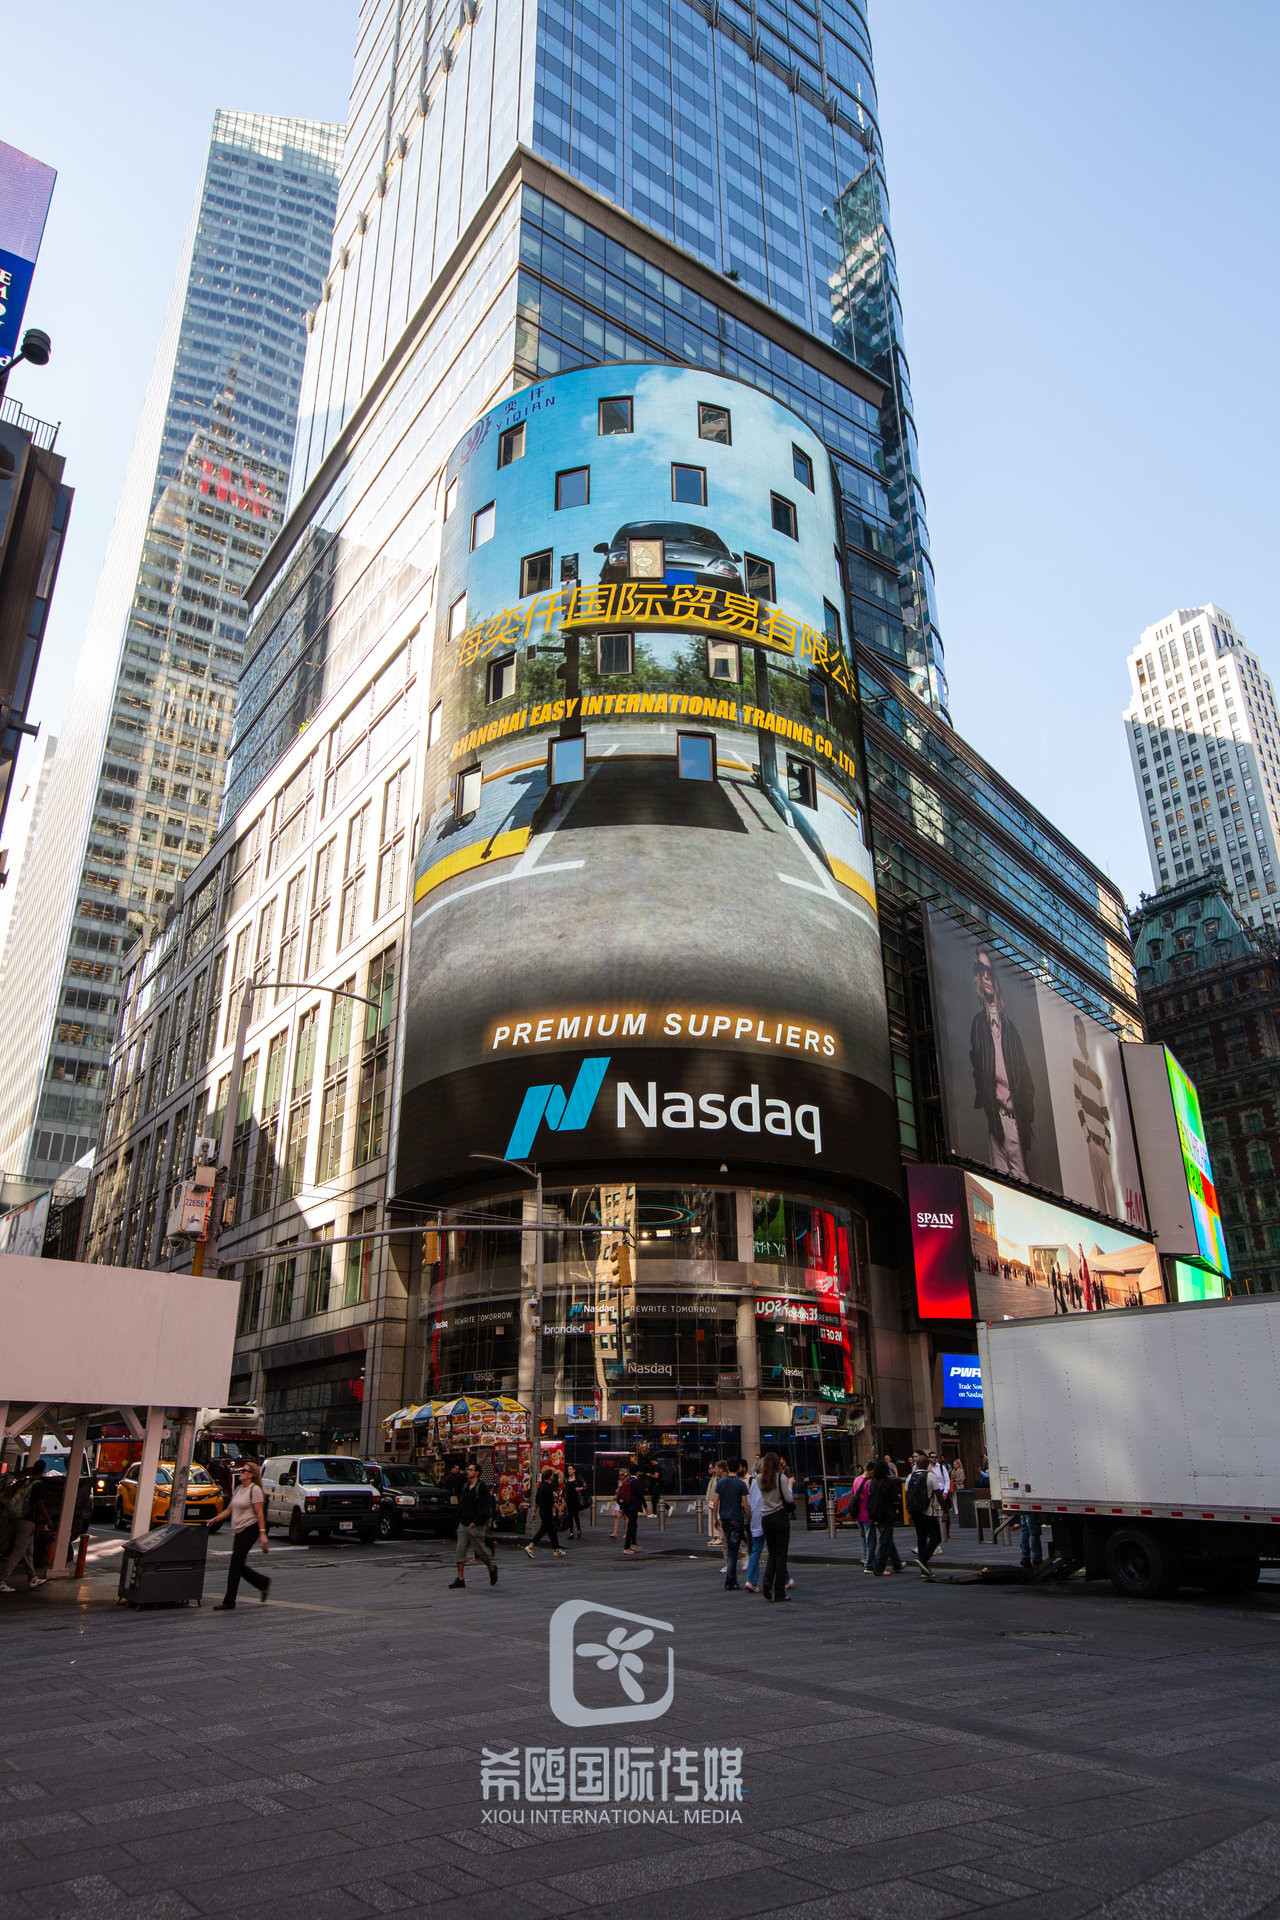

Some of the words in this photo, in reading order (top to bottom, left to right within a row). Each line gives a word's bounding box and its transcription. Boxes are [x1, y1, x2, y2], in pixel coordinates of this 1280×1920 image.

[496, 396, 555, 431] YIQIAN
[431, 583, 858, 703] 上海奕仟国际贸易有限公
[451, 709, 528, 762] SHANGHAI
[529, 697, 579, 727] EASY
[579, 693, 738, 721] INTERNATIONAL
[743, 705, 813, 746] TRADING
[839, 750, 856, 778] LTD
[492, 1013, 647, 1050] PREMIUM
[663, 1013, 836, 1056] SUPPLIERS
[617, 1082, 823, 1154] Nasdaq
[916, 1212, 954, 1224] SPAIN
[477, 1312, 513, 1322] TOMORROW
[584, 1304, 615, 1314] Nasdaq
[630, 1305, 667, 1313] REWRITE
[671, 1305, 718, 1314] TOMORROW
[628, 1363, 673, 1377] Nasdaq
